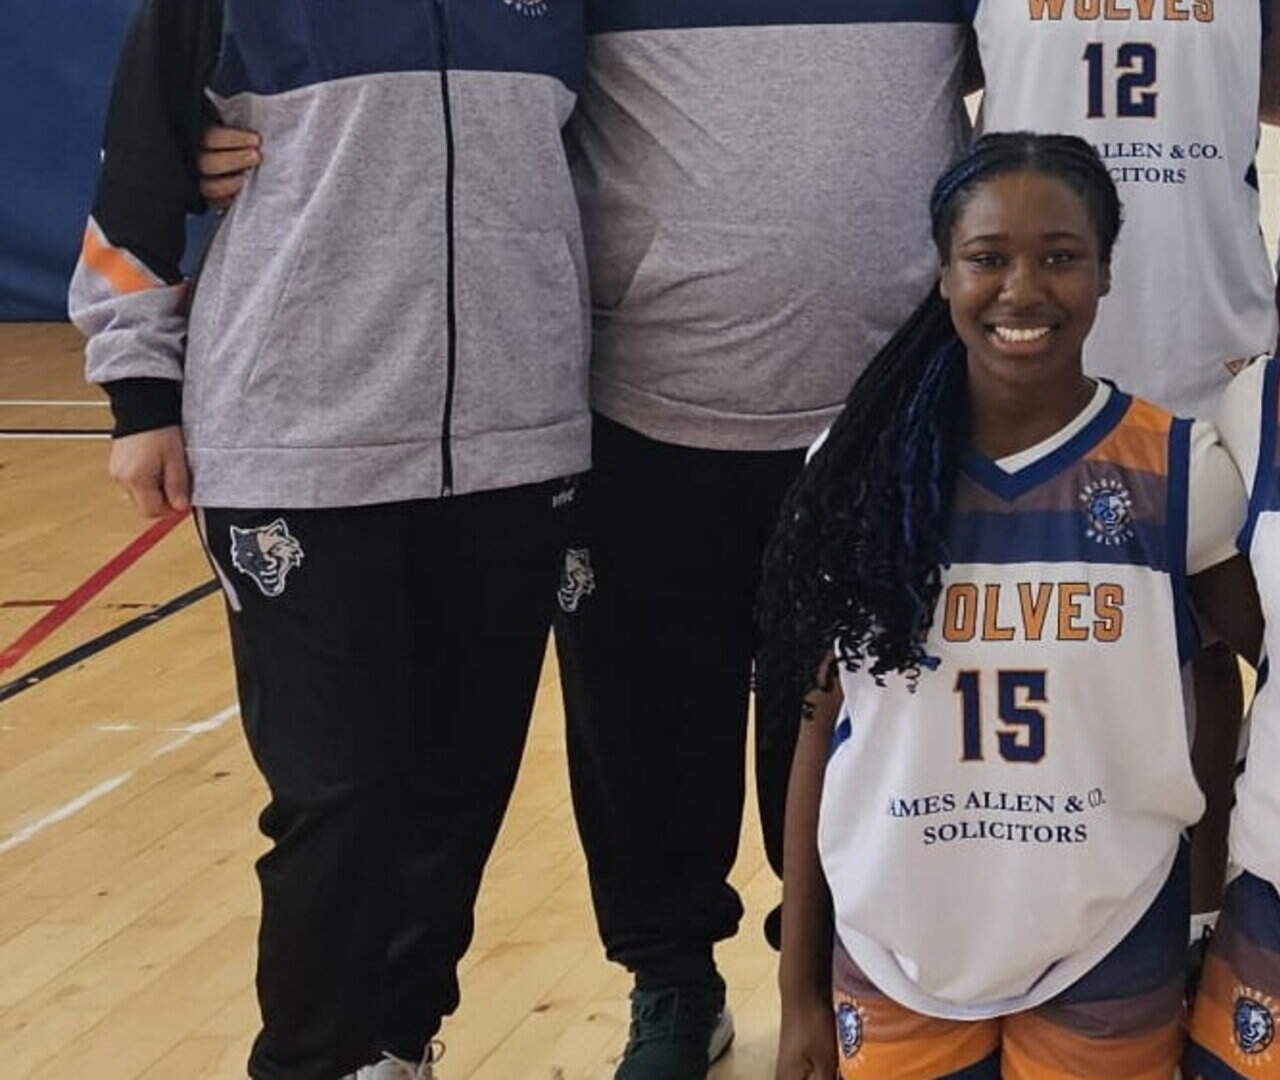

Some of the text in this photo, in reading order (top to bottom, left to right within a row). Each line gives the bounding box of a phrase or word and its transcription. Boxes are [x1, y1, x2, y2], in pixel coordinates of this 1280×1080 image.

[1081, 42, 1158, 119] 12
[1092, 142, 1222, 161] LLEN & CO.
[1110, 166, 1187, 184] CITORS
[922, 583, 1125, 643] OLVES
[953, 669, 1048, 763] 15
[887, 793, 955, 817] AMES
[965, 791, 1055, 813] ALLEN
[1064, 796, 1084, 813] &
[923, 821, 1088, 845] SOLICITORS
